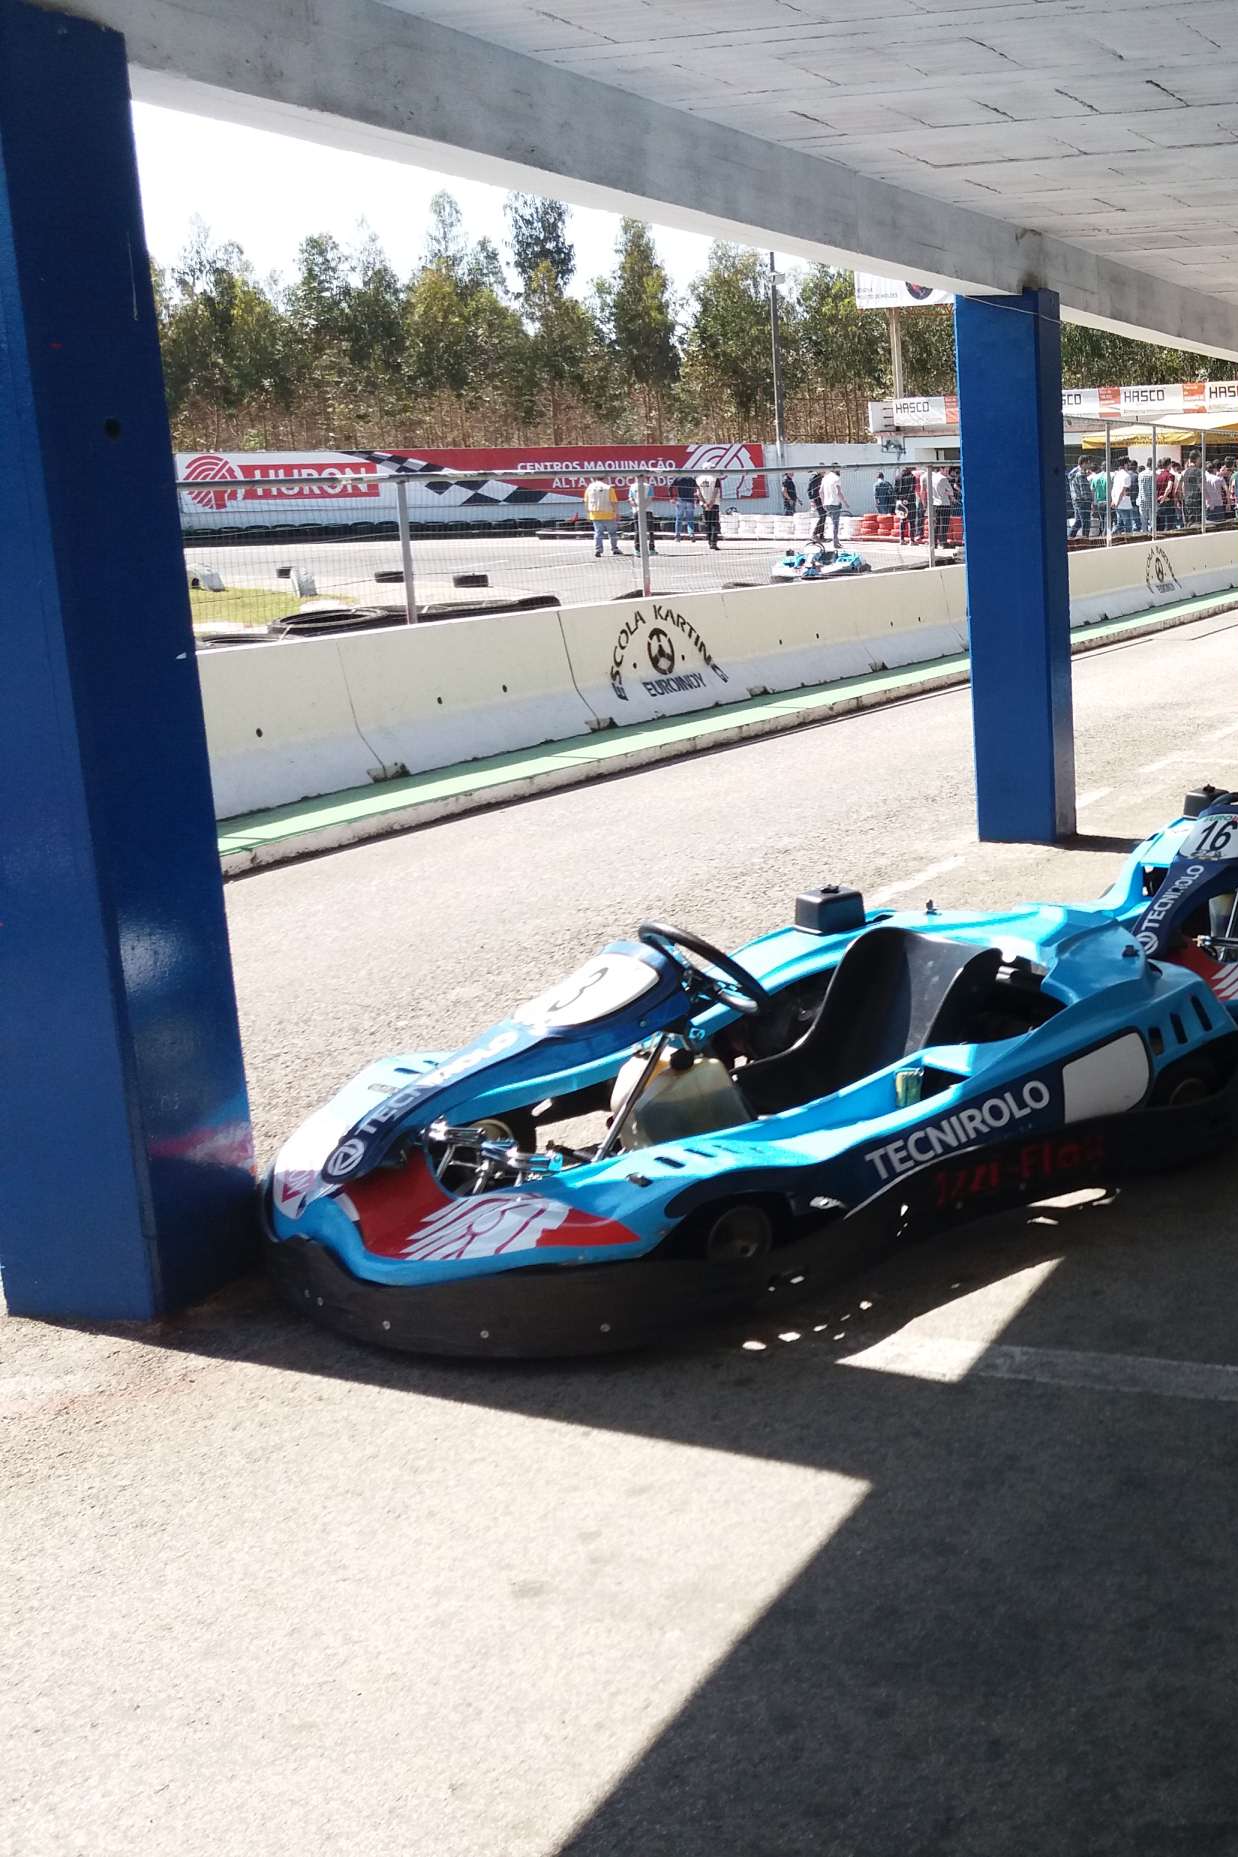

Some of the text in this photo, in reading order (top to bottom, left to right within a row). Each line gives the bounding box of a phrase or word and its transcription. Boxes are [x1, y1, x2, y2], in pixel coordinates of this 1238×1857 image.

[895, 401, 930, 414] HASCO
[1124, 389, 1165, 403] HASCO
[254, 467, 369, 496] HURON
[552, 476, 588, 488] ALTA
[610, 604, 729, 701] ESCOLA KARTING
[641, 672, 707, 698] EUROINDY
[1195, 820, 1238, 852] 16
[1141, 864, 1205, 931] TECNIROLO
[864, 1080, 1050, 1180] TECNIROLO
